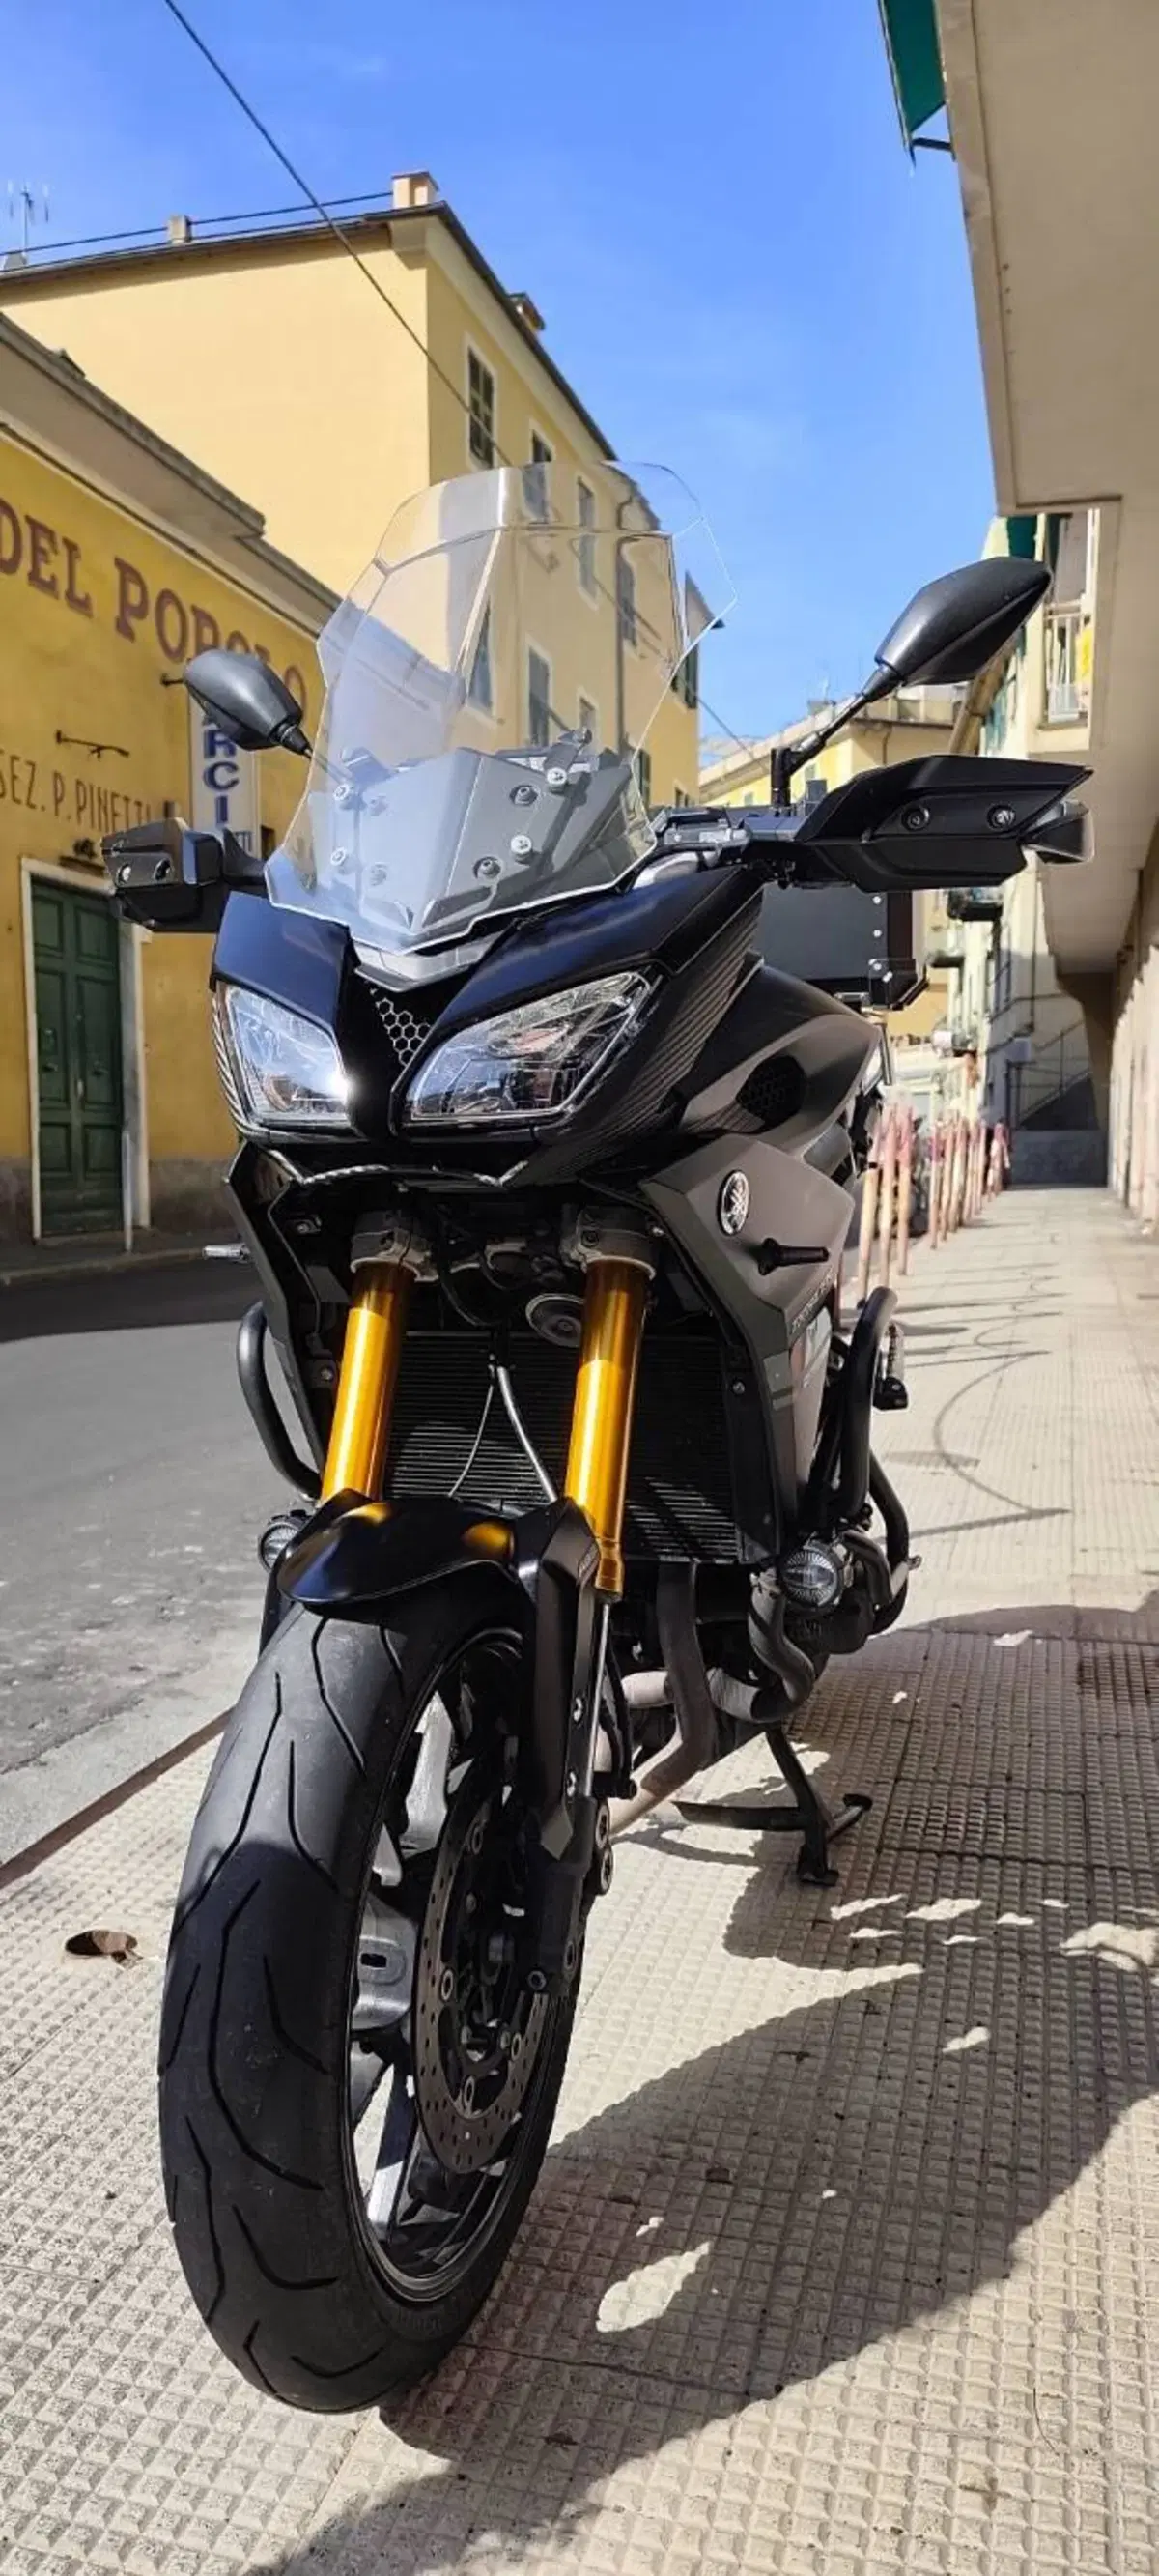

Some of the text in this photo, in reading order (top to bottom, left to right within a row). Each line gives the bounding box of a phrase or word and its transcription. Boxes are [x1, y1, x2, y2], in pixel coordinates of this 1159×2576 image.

[0, 497, 307, 721] DEL POPO
[203, 715, 240, 824] RCI
